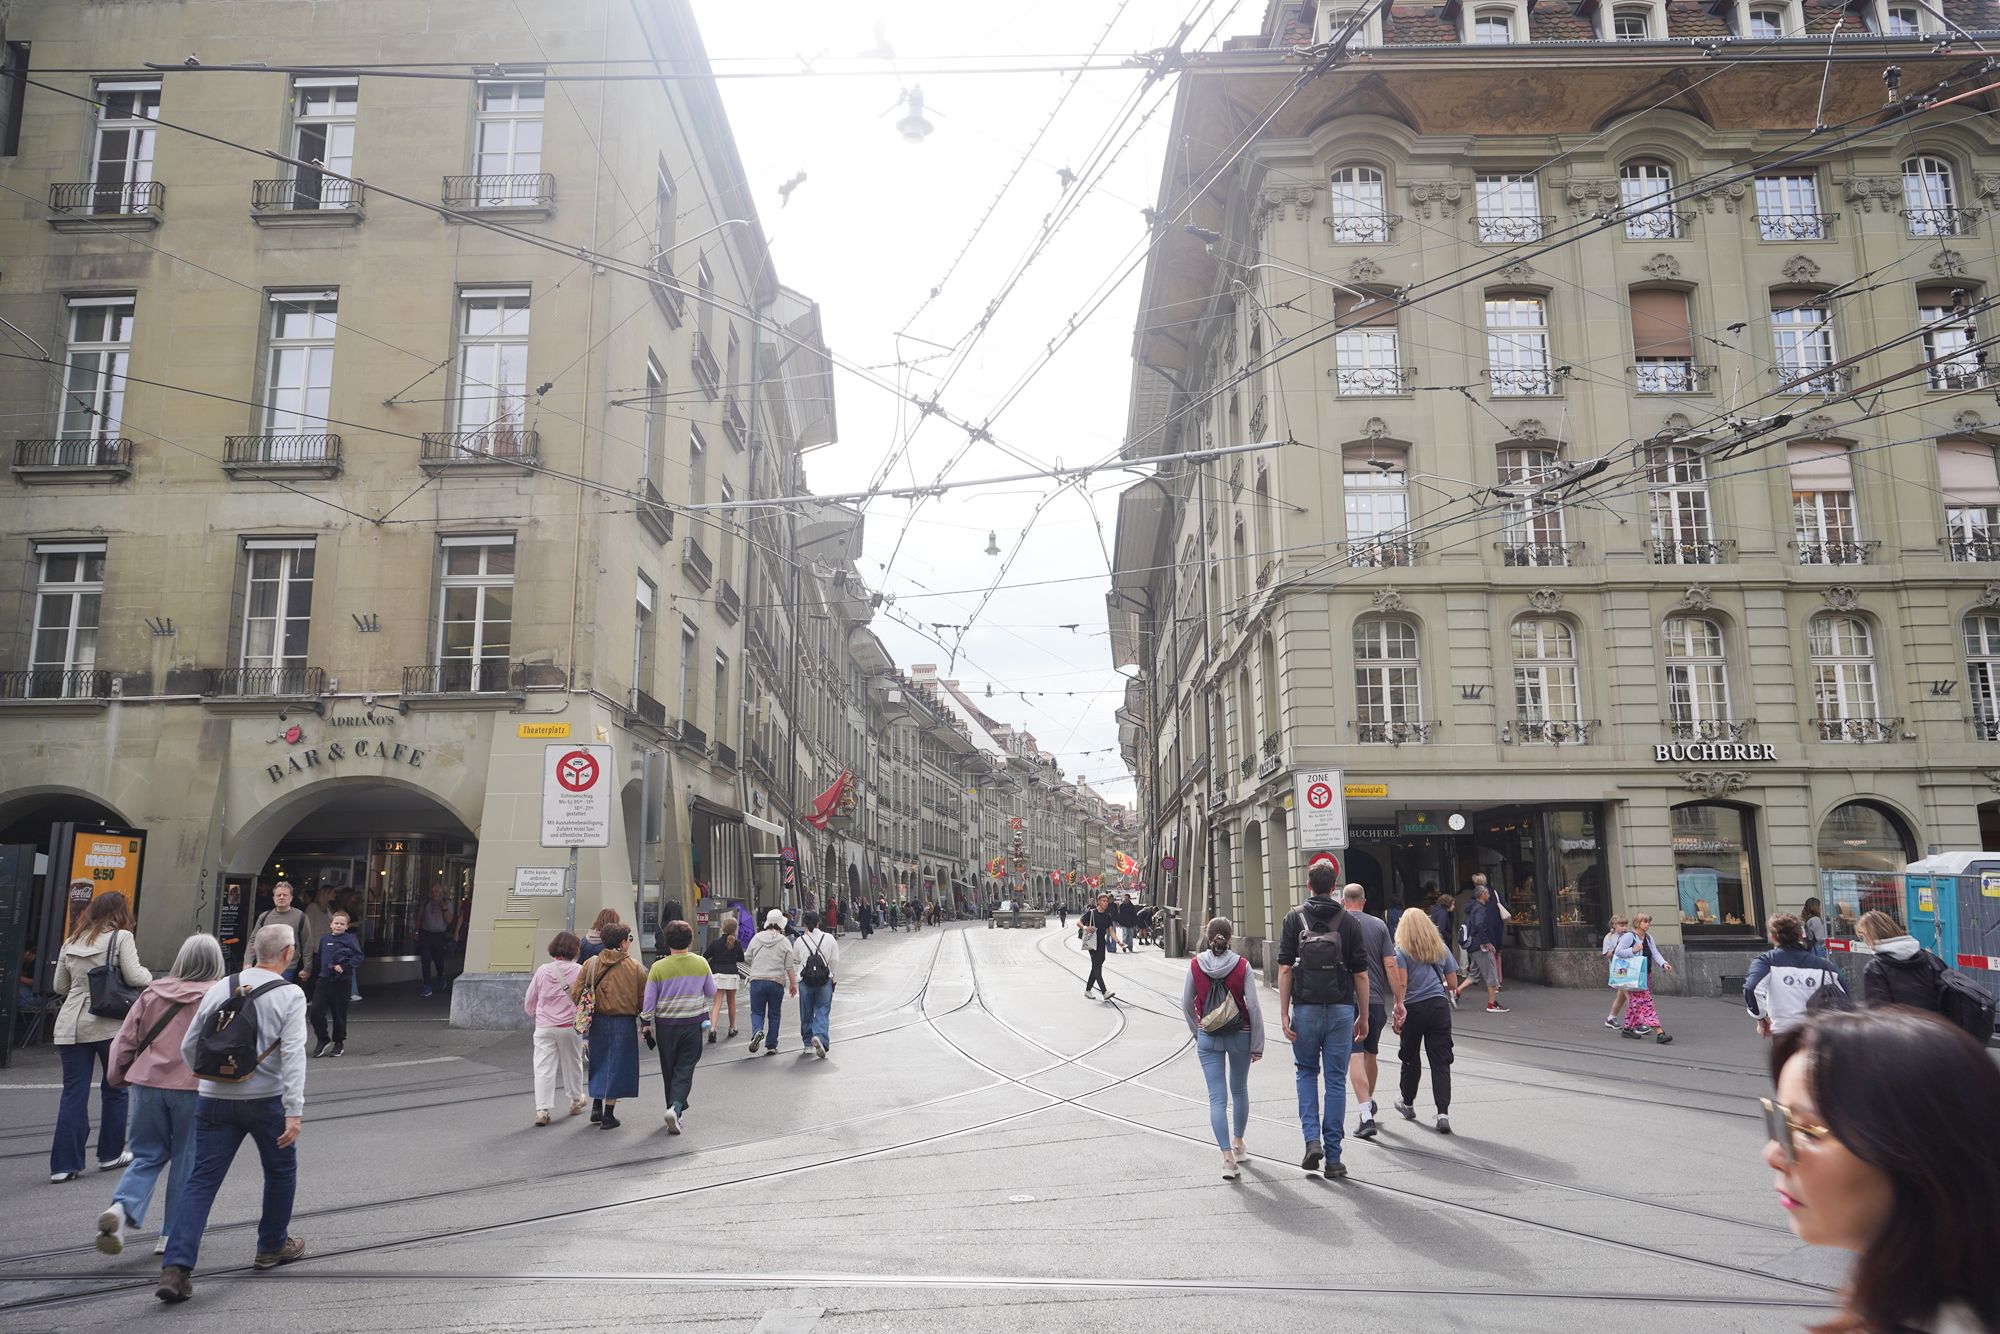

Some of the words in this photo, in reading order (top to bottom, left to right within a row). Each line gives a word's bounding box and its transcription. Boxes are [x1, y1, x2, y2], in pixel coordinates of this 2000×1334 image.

[328, 714, 395, 727] ADRIANO'S
[523, 725, 565, 736] Theaterplatz
[1654, 743, 1778, 761] BUCHERER
[265, 749, 321, 783] BAR
[328, 742, 345, 761] &
[355, 739, 425, 768] CAFE
[1307, 773, 1329, 783] ZONE
[1344, 785, 1384, 795] Kornhausplatz
[1349, 829, 1399, 838] BUCHERE
[1405, 824, 1440, 832] ROLEX
[84, 854, 126, 868] menus
